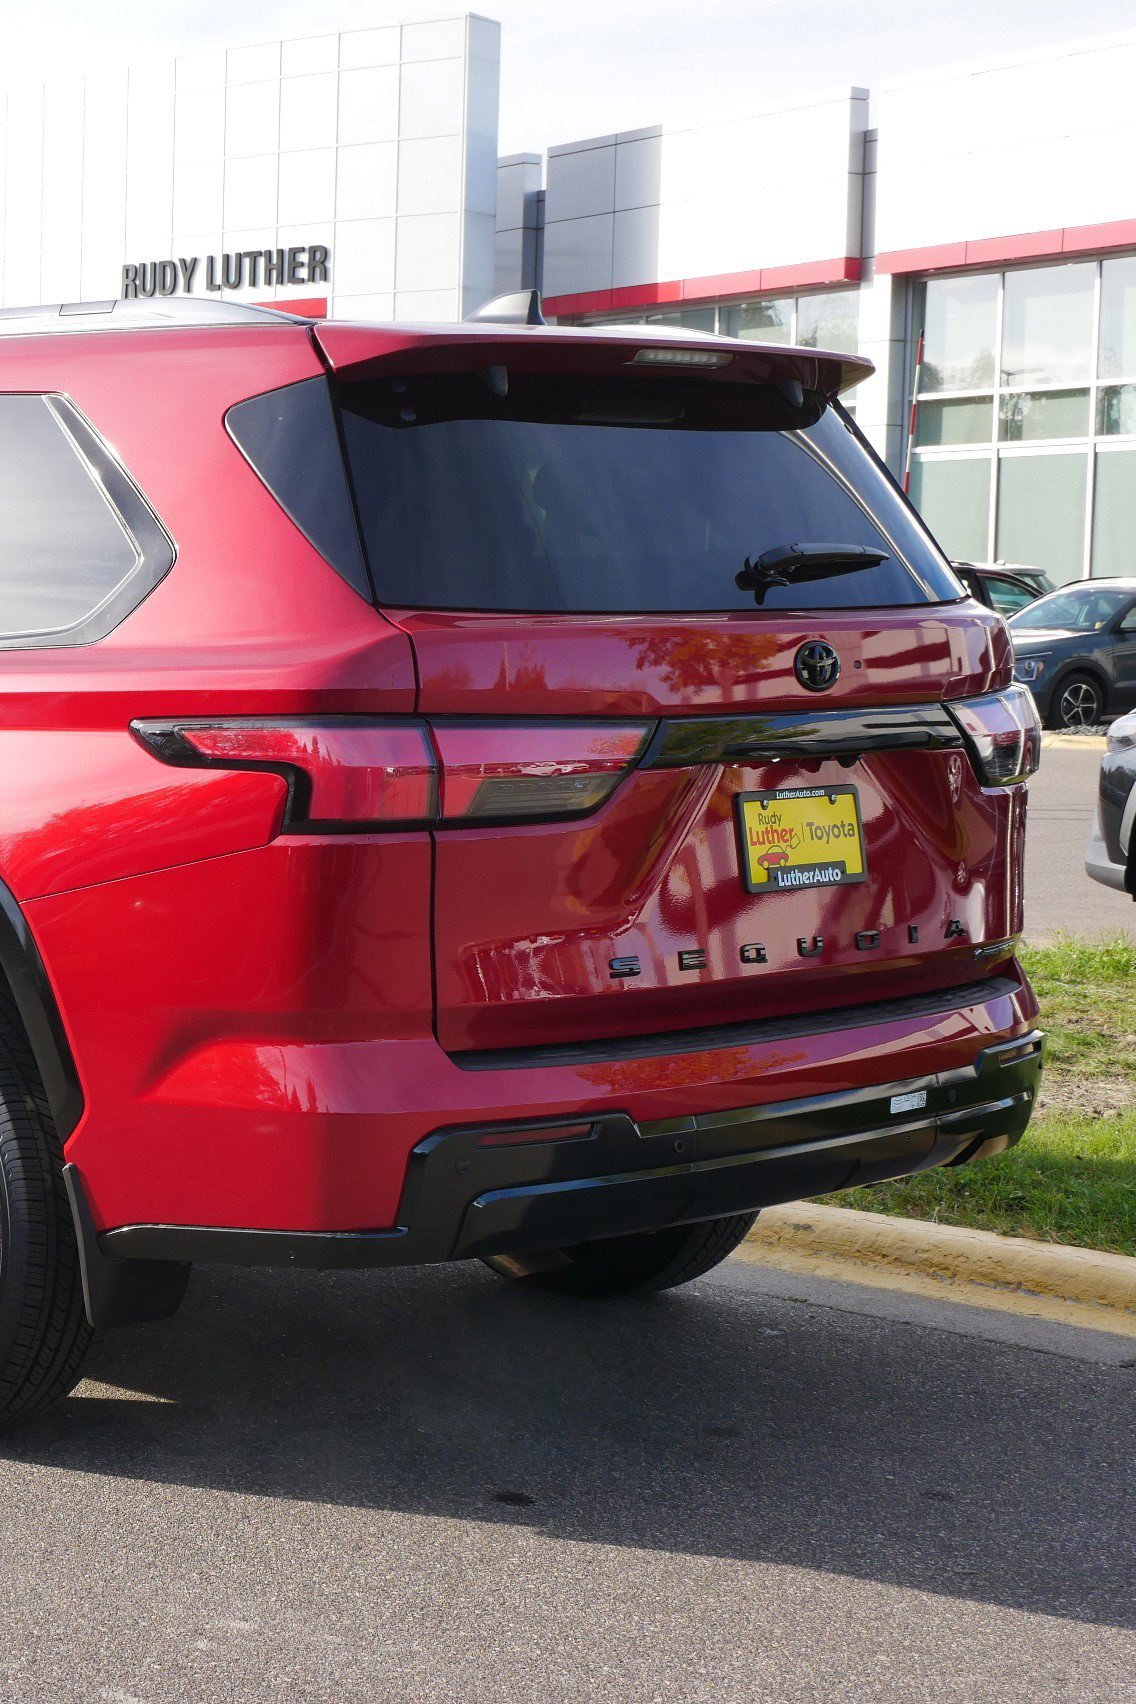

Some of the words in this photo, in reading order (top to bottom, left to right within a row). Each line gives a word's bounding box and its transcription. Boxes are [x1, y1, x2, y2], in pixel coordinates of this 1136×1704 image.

[121, 257, 198, 299] RUDY
[206, 245, 329, 291] LUTHER
[776, 789, 825, 800] LutherAuto.com
[758, 811, 782, 827] Rudy
[749, 825, 794, 847] Luther
[806, 820, 856, 845] Toyota
[777, 866, 842, 887] LutherAuto
[609, 919, 966, 979] SEQUOIA
